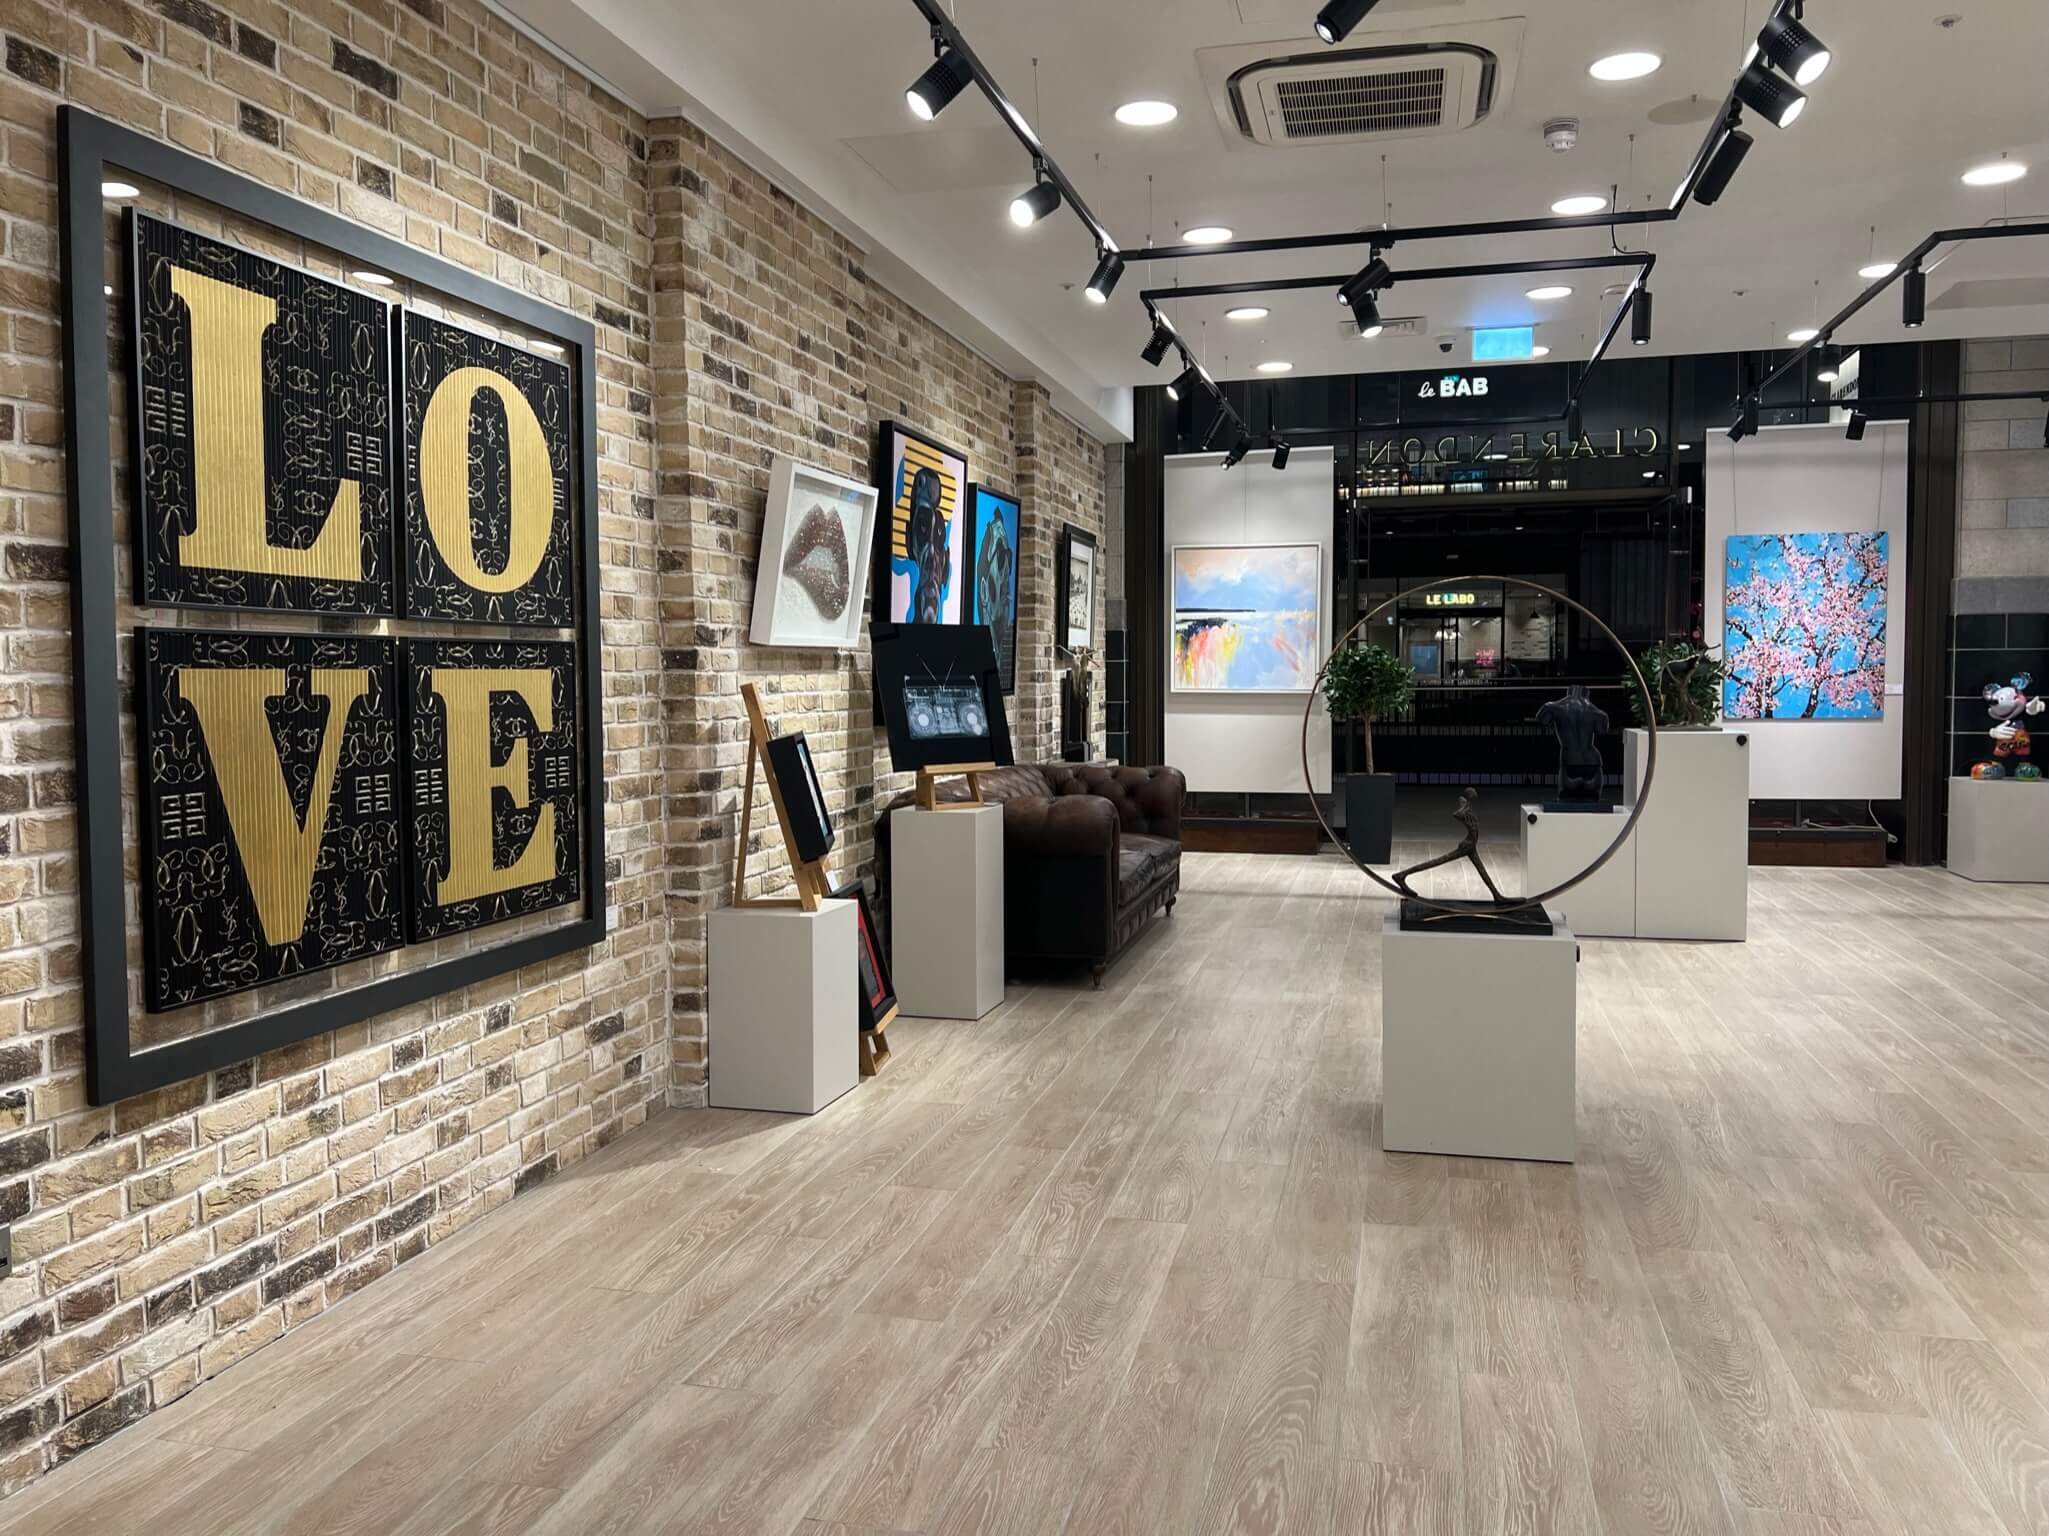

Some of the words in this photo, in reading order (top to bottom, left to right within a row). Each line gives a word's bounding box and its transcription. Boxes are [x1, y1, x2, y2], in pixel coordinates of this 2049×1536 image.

[1418, 381, 1436, 398] le
[1440, 377, 1488, 397] BAB
[1426, 594, 1441, 605] LE
[1444, 593, 1475, 604] LABO
